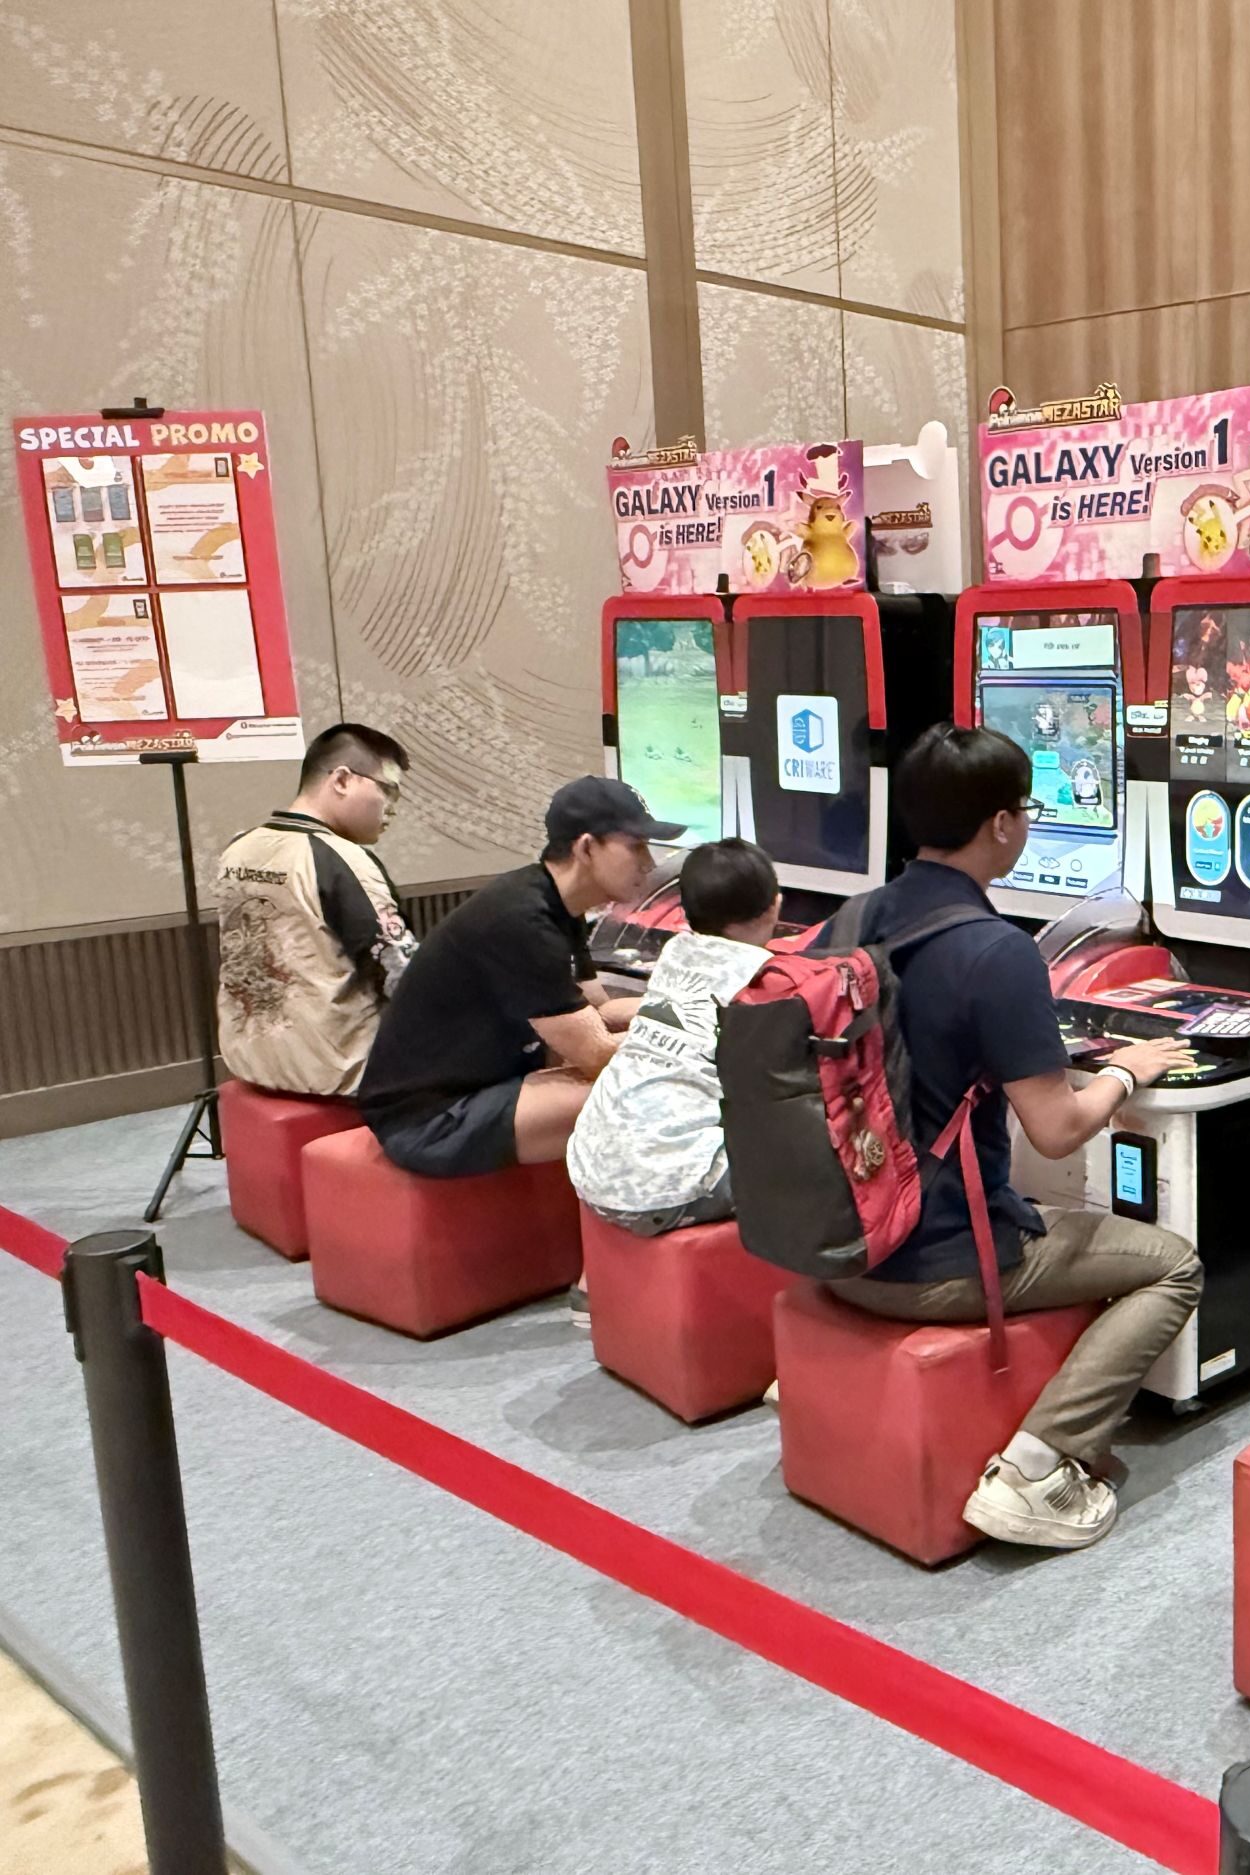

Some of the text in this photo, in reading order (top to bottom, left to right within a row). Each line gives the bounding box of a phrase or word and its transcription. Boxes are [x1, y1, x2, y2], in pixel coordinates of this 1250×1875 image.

[19, 421, 259, 450] SPECIAL PROMO
[989, 418, 1229, 488] GALAXY Version 1
[615, 469, 776, 518] GALAXY Version 1
[1050, 481, 1152, 522] is HERE!
[658, 516, 723, 546] is HERE!
[784, 758, 836, 780] CRIWARE
